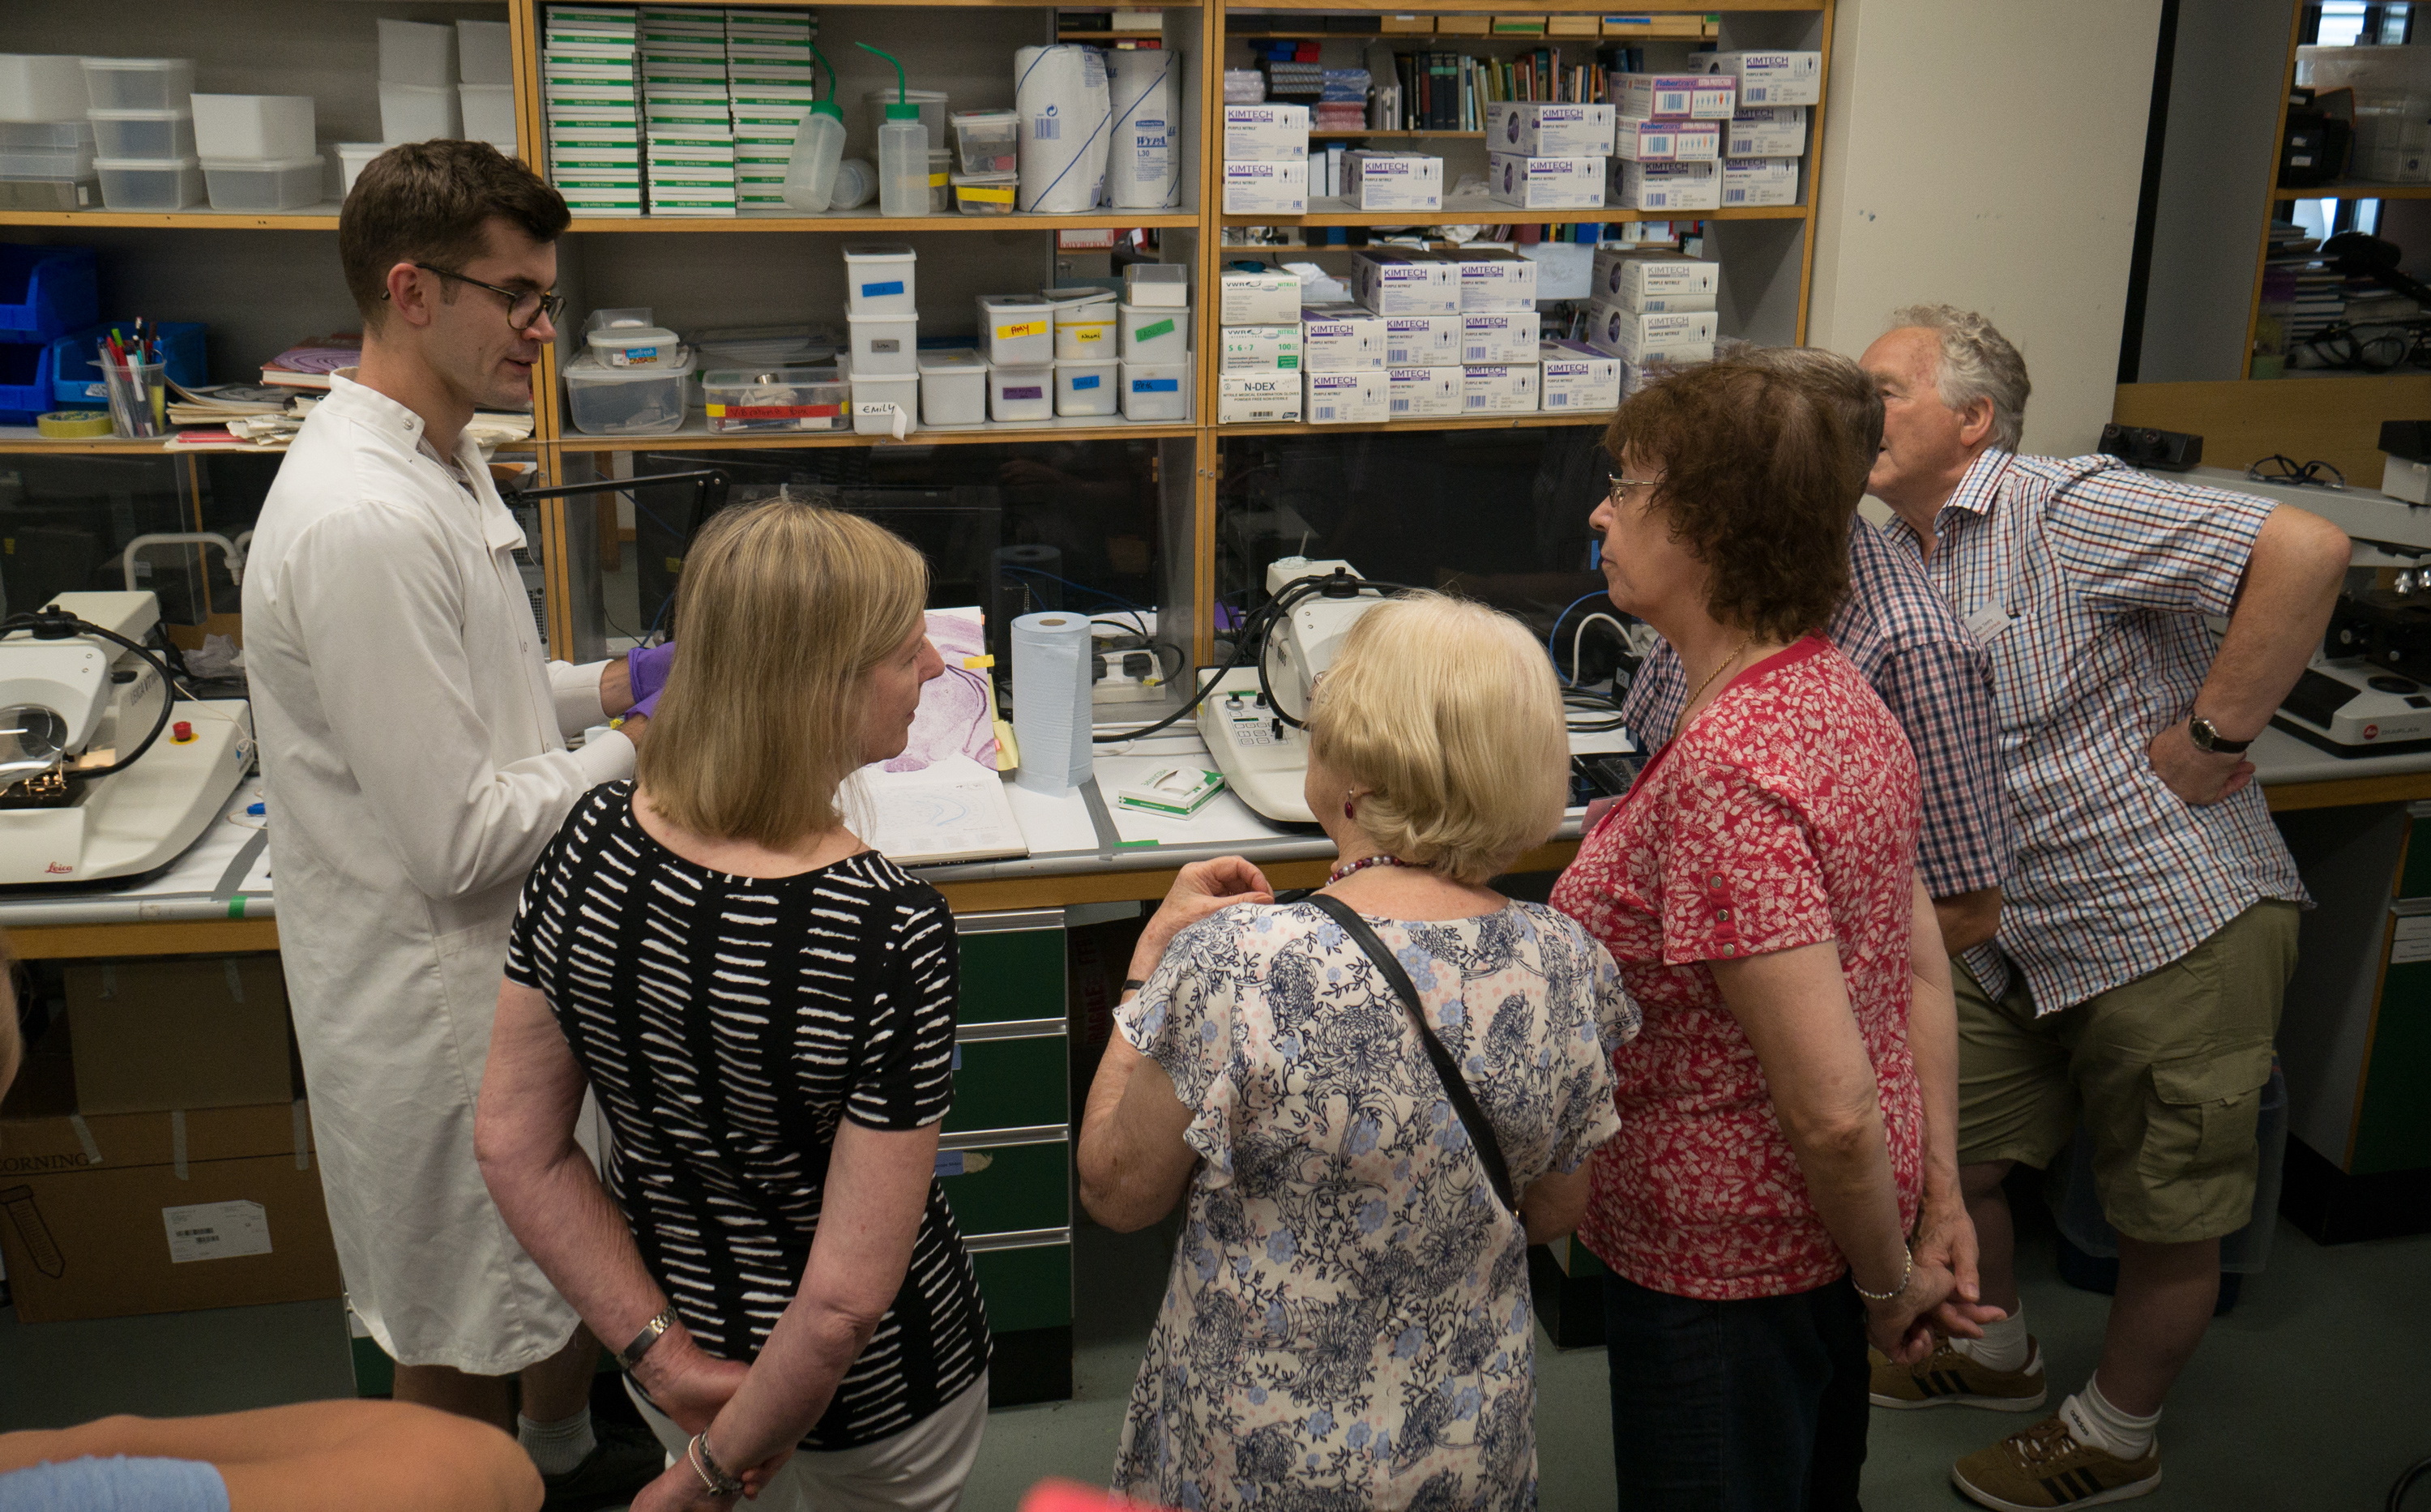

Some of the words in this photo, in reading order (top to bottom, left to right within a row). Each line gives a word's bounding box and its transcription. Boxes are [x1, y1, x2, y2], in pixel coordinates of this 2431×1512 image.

[1746, 56, 1788, 66] KIMTECH
[1228, 110, 1273, 118] KIMTECH
[1726, 159, 1767, 167] KIMTECH
[1648, 316, 1689, 325] KIMTECH
[1011, 324, 1029, 335] AMY
[1548, 364, 1588, 372] KIMTECH
[1134, 381, 1153, 390] Beth
[1245, 382, 1275, 391] N-DEX
[45, 861, 73, 873] Leica
[0, 1152, 89, 1171] ORNING
[2070, 1410, 2089, 1436] adidas
